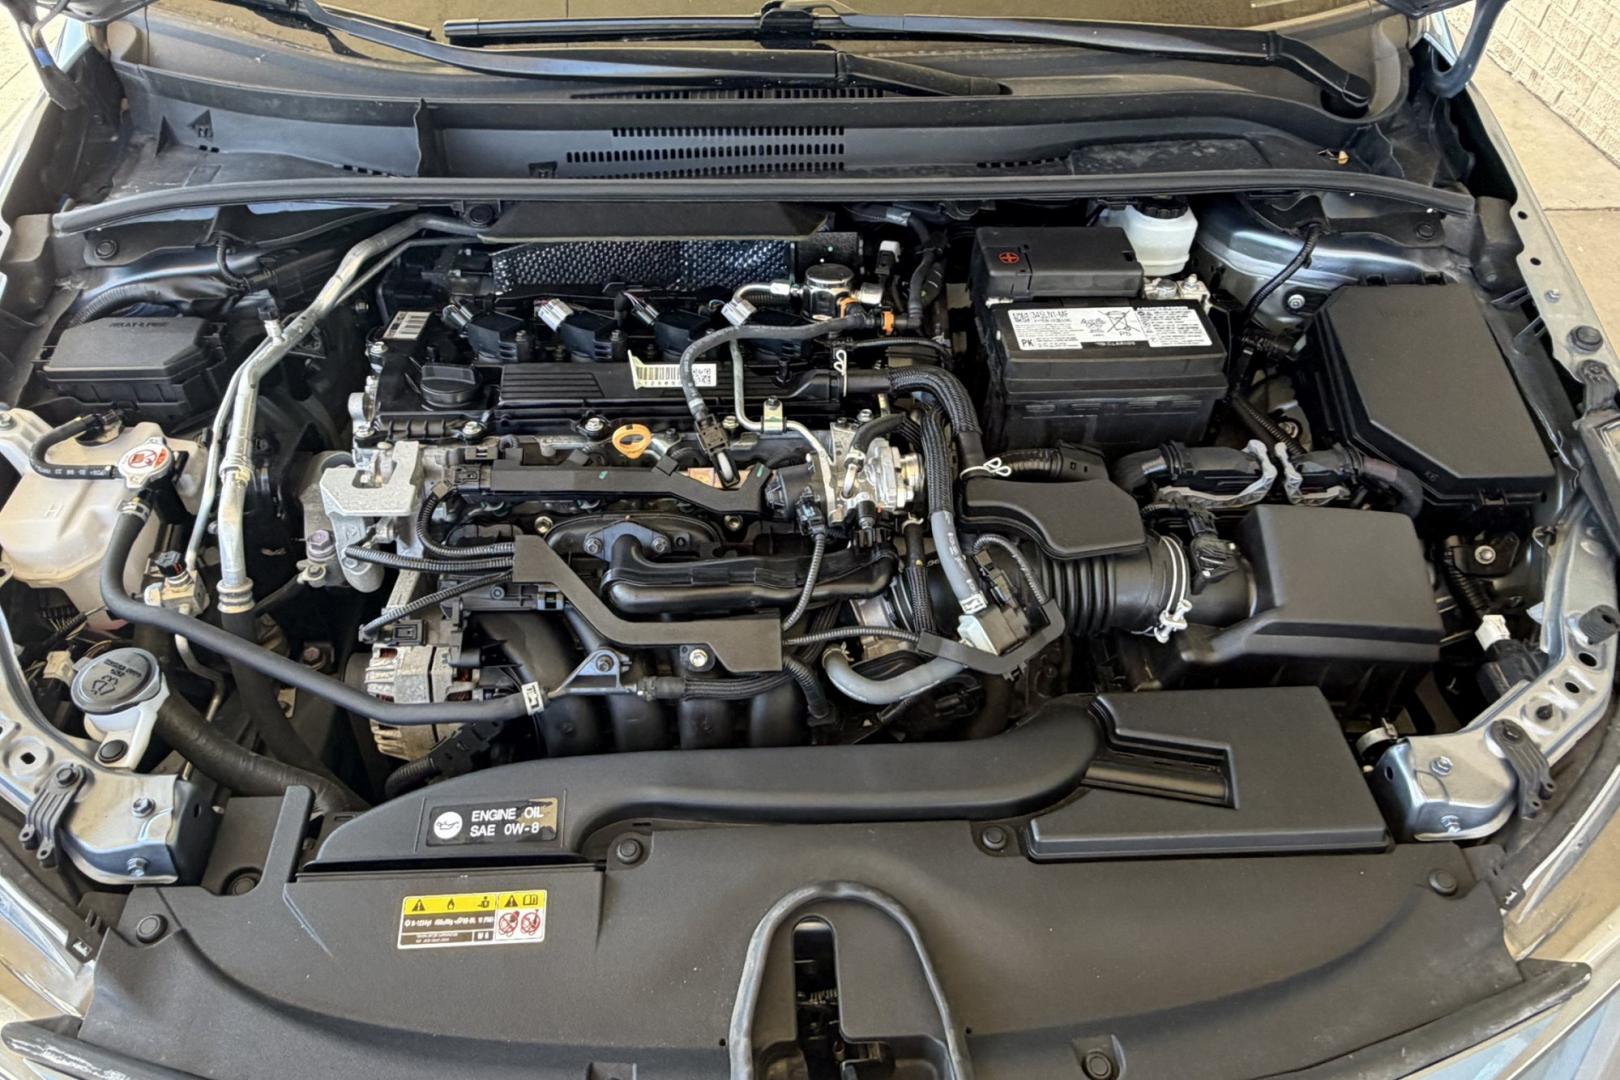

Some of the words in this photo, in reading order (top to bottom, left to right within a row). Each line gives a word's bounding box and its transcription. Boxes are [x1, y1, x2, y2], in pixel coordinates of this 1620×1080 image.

[471, 808, 517, 822] ENGINE
[523, 806, 545, 819] OIL
[469, 824, 497, 838] SAE
[504, 822, 540, 836] 0W-8
